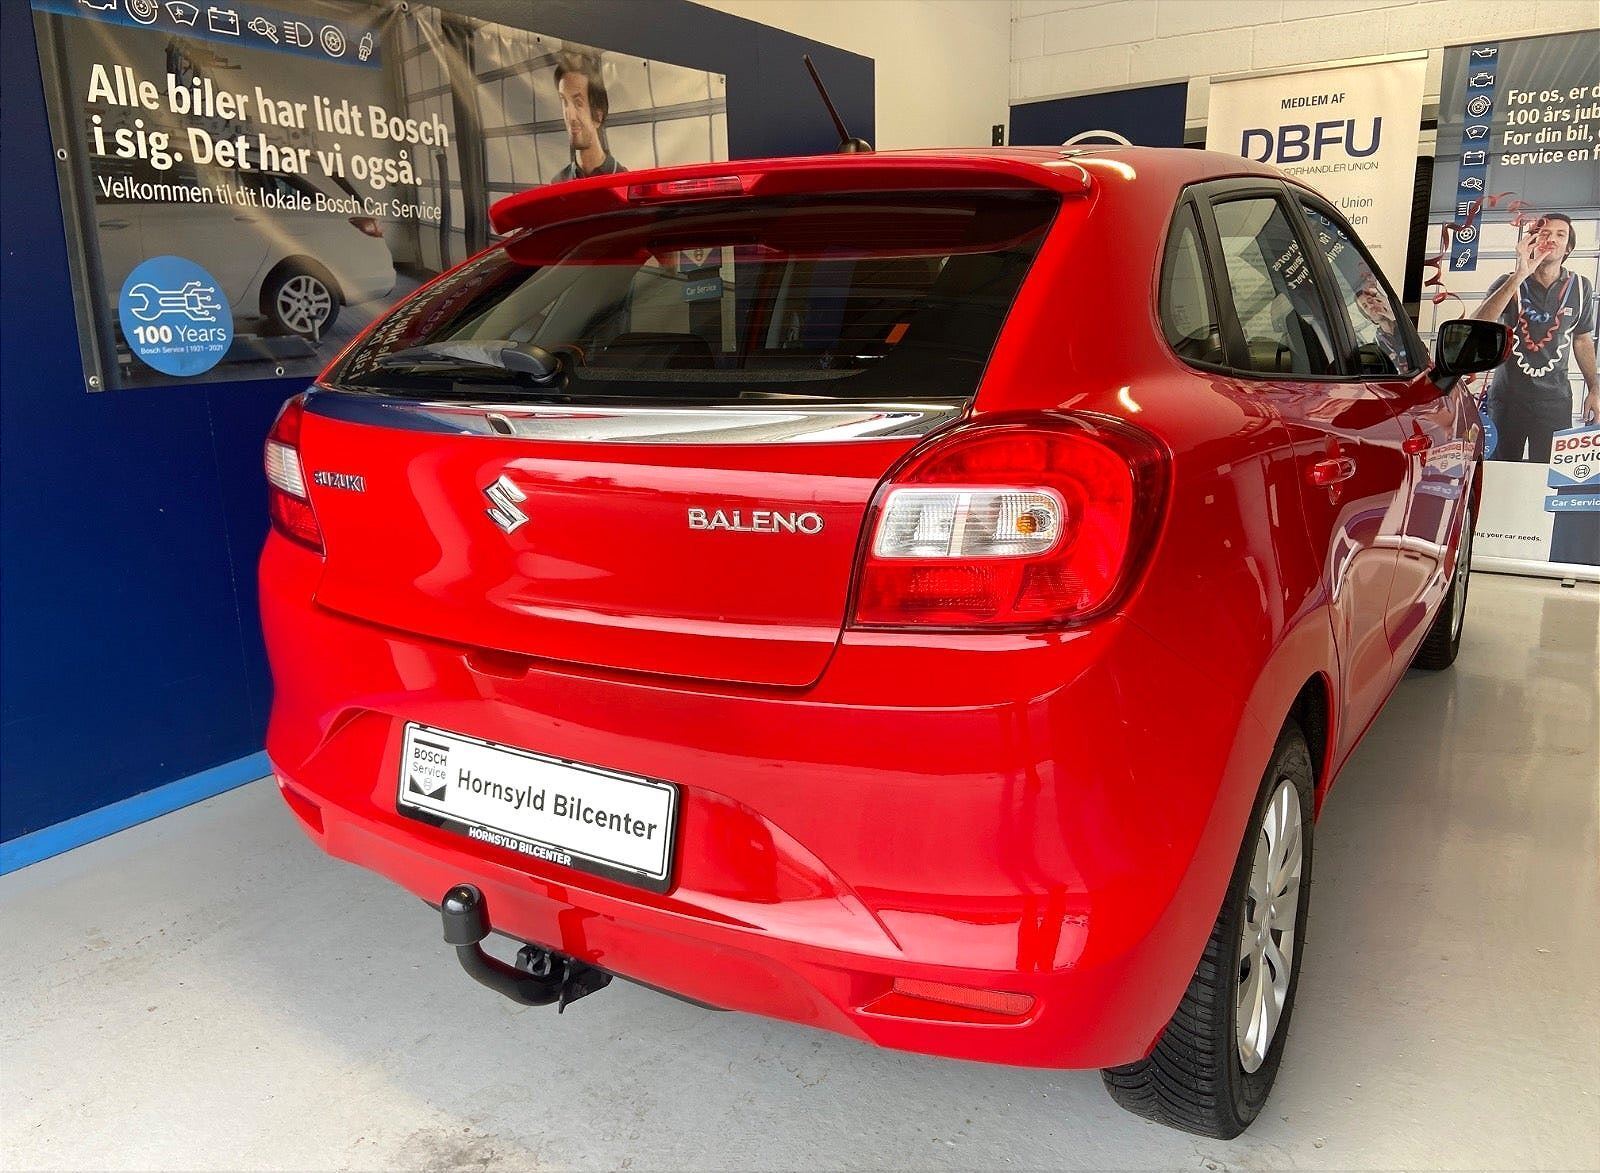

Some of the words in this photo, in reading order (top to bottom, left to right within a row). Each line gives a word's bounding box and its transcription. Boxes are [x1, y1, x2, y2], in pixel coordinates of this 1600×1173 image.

[87, 64, 160, 110] Alle
[166, 73, 249, 121] biler
[255, 87, 307, 129] har
[314, 95, 365, 137] lidt
[368, 105, 449, 147] Bosch
[1281, 94, 1328, 109] MEDLEM
[1331, 92, 1346, 104] AF
[1507, 89, 1537, 106] For
[1539, 89, 1564, 103] os,
[1569, 86, 1589, 100] er
[1506, 108, 1540, 126] 100
[1543, 105, 1571, 123] års
[1241, 116, 1383, 164] DBFU
[1503, 130, 1532, 146] For
[1535, 127, 1562, 144] din
[1566, 124, 1593, 142] bil,
[91, 115, 105, 156] i
[115, 119, 183, 171] sig.
[187, 127, 251, 170] Det
[259, 133, 311, 174] har
[317, 143, 345, 178] vi
[351, 150, 423, 190] også.
[1501, 147, 1564, 166] service
[1567, 149, 1589, 162] en
[1348, 161, 1379, 172] UNION
[98, 175, 213, 203] Velkommen
[216, 184, 233, 205] til
[235, 186, 258, 207] dit
[260, 187, 311, 211] lokale
[315, 192, 361, 214] Bosch
[364, 197, 388, 216] Car
[392, 199, 441, 220] Service
[1341, 195, 1373, 208] Union
[133, 325, 173, 344] 100
[175, 324, 227, 342] Years
[140, 347, 161, 355] Bosch
[162, 346, 185, 354] Service
[1555, 434, 1600, 451] BOSC
[314, 471, 366, 493] SUZUKI
[1551, 499, 1569, 507] Car
[687, 508, 824, 535] BALENO
[414, 747, 447, 766] BOSCH
[413, 761, 446, 780] Service
[458, 768, 546, 811] Hornsyld
[553, 793, 658, 840] Bilcenter
[469, 826, 517, 850] HORNSYLD
[518, 841, 572, 866] BILCENTER
